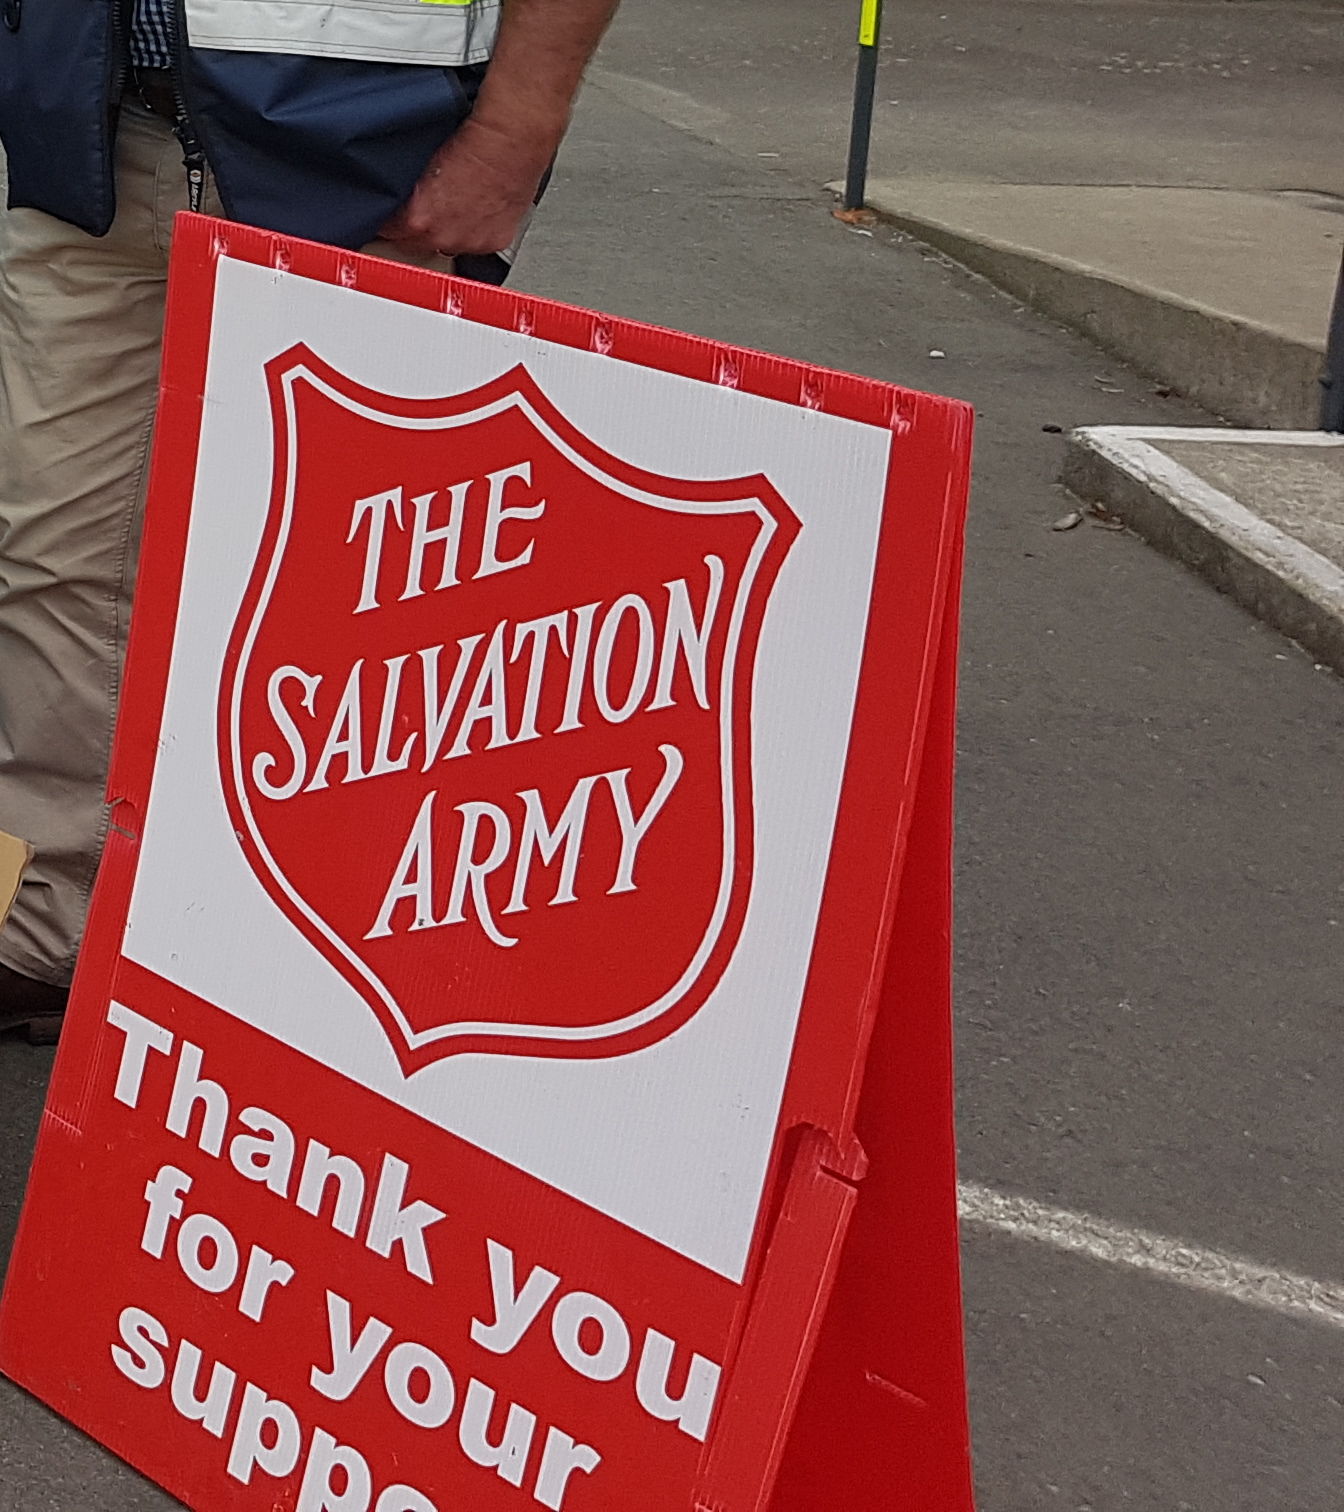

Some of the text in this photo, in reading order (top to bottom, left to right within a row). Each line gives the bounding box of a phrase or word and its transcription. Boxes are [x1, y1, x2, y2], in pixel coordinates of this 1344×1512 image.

[345, 461, 547, 616] THE
[252, 554, 722, 803] SALVATION
[363, 742, 683, 950] ARMY
[106, 999, 723, 1442] Thank you
[140, 1165, 602, 1512] for your
